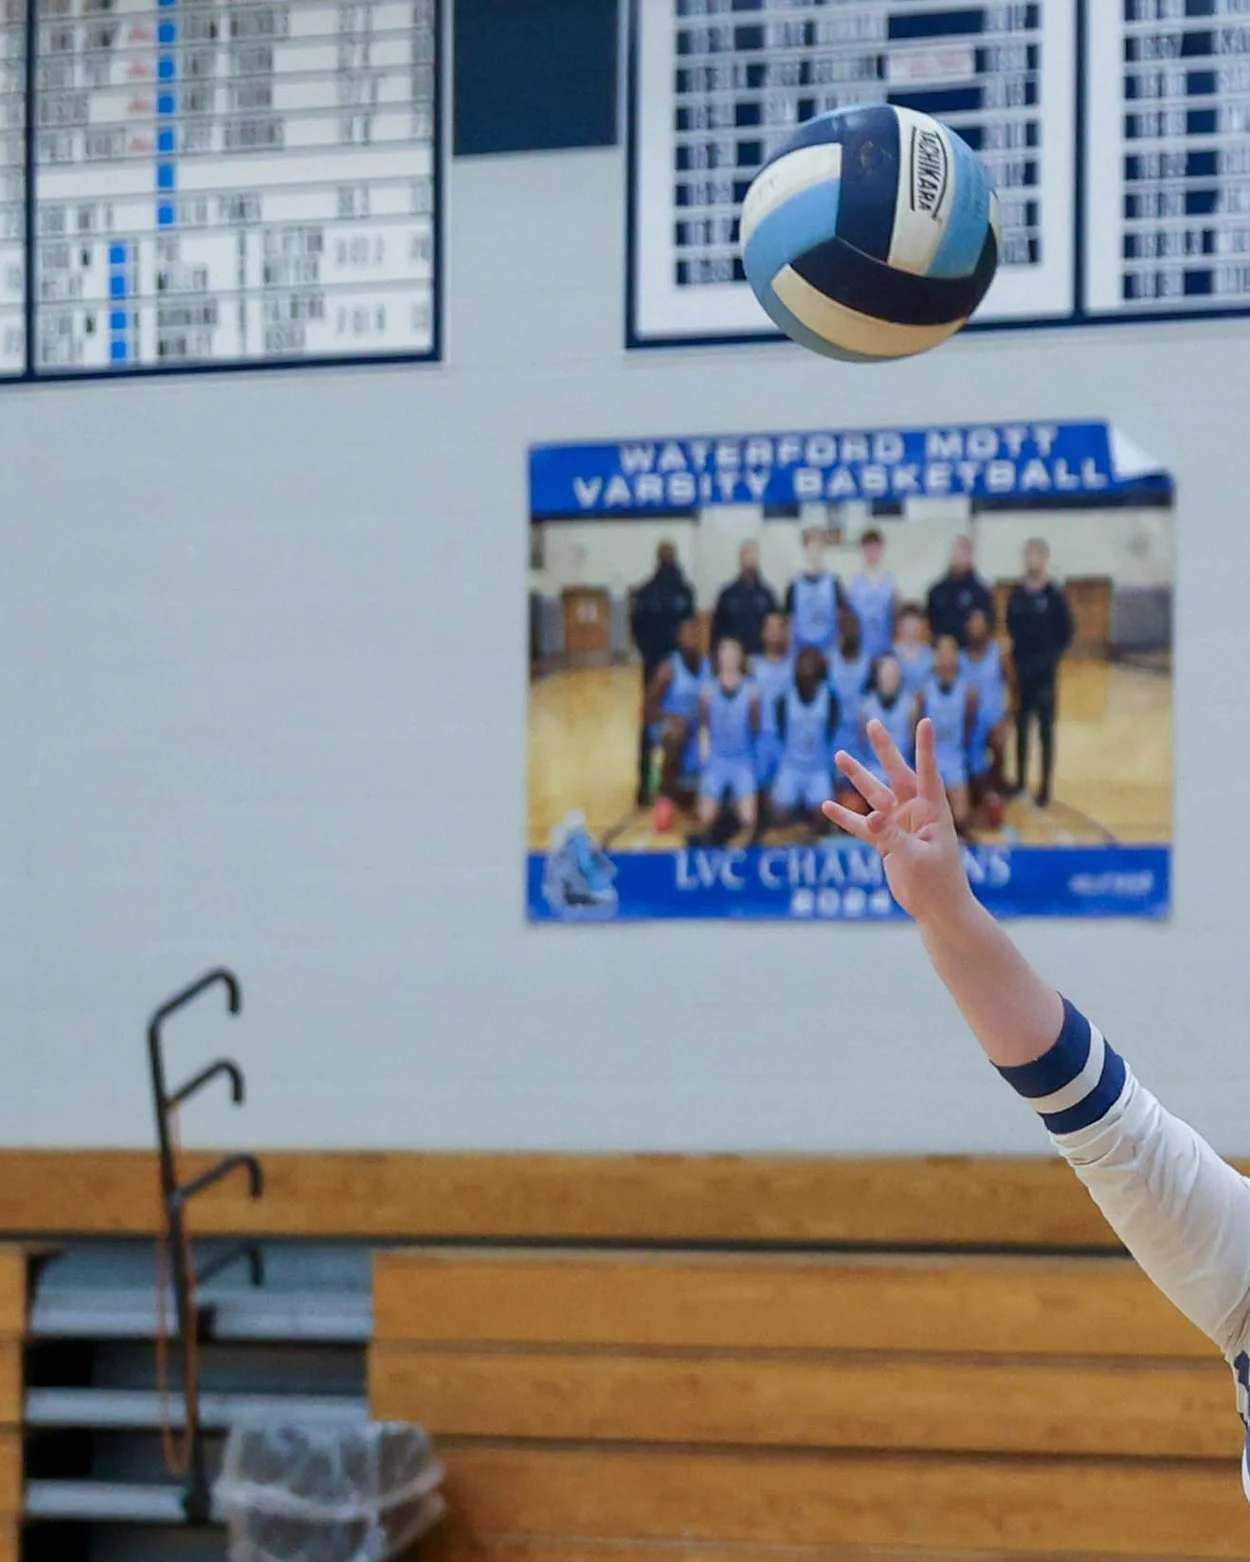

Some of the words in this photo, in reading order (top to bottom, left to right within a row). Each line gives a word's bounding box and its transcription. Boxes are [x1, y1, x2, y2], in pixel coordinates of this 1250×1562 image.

[918, 131, 941, 210] TACHIKARA
[618, 431, 905, 474] WATERFORD
[925, 424, 1058, 460] MOTT
[573, 467, 770, 508] VARSITY
[793, 457, 1108, 501] BASKETBALL
[674, 846, 747, 890] LVC
[758, 845, 1012, 889] CHAMNS
